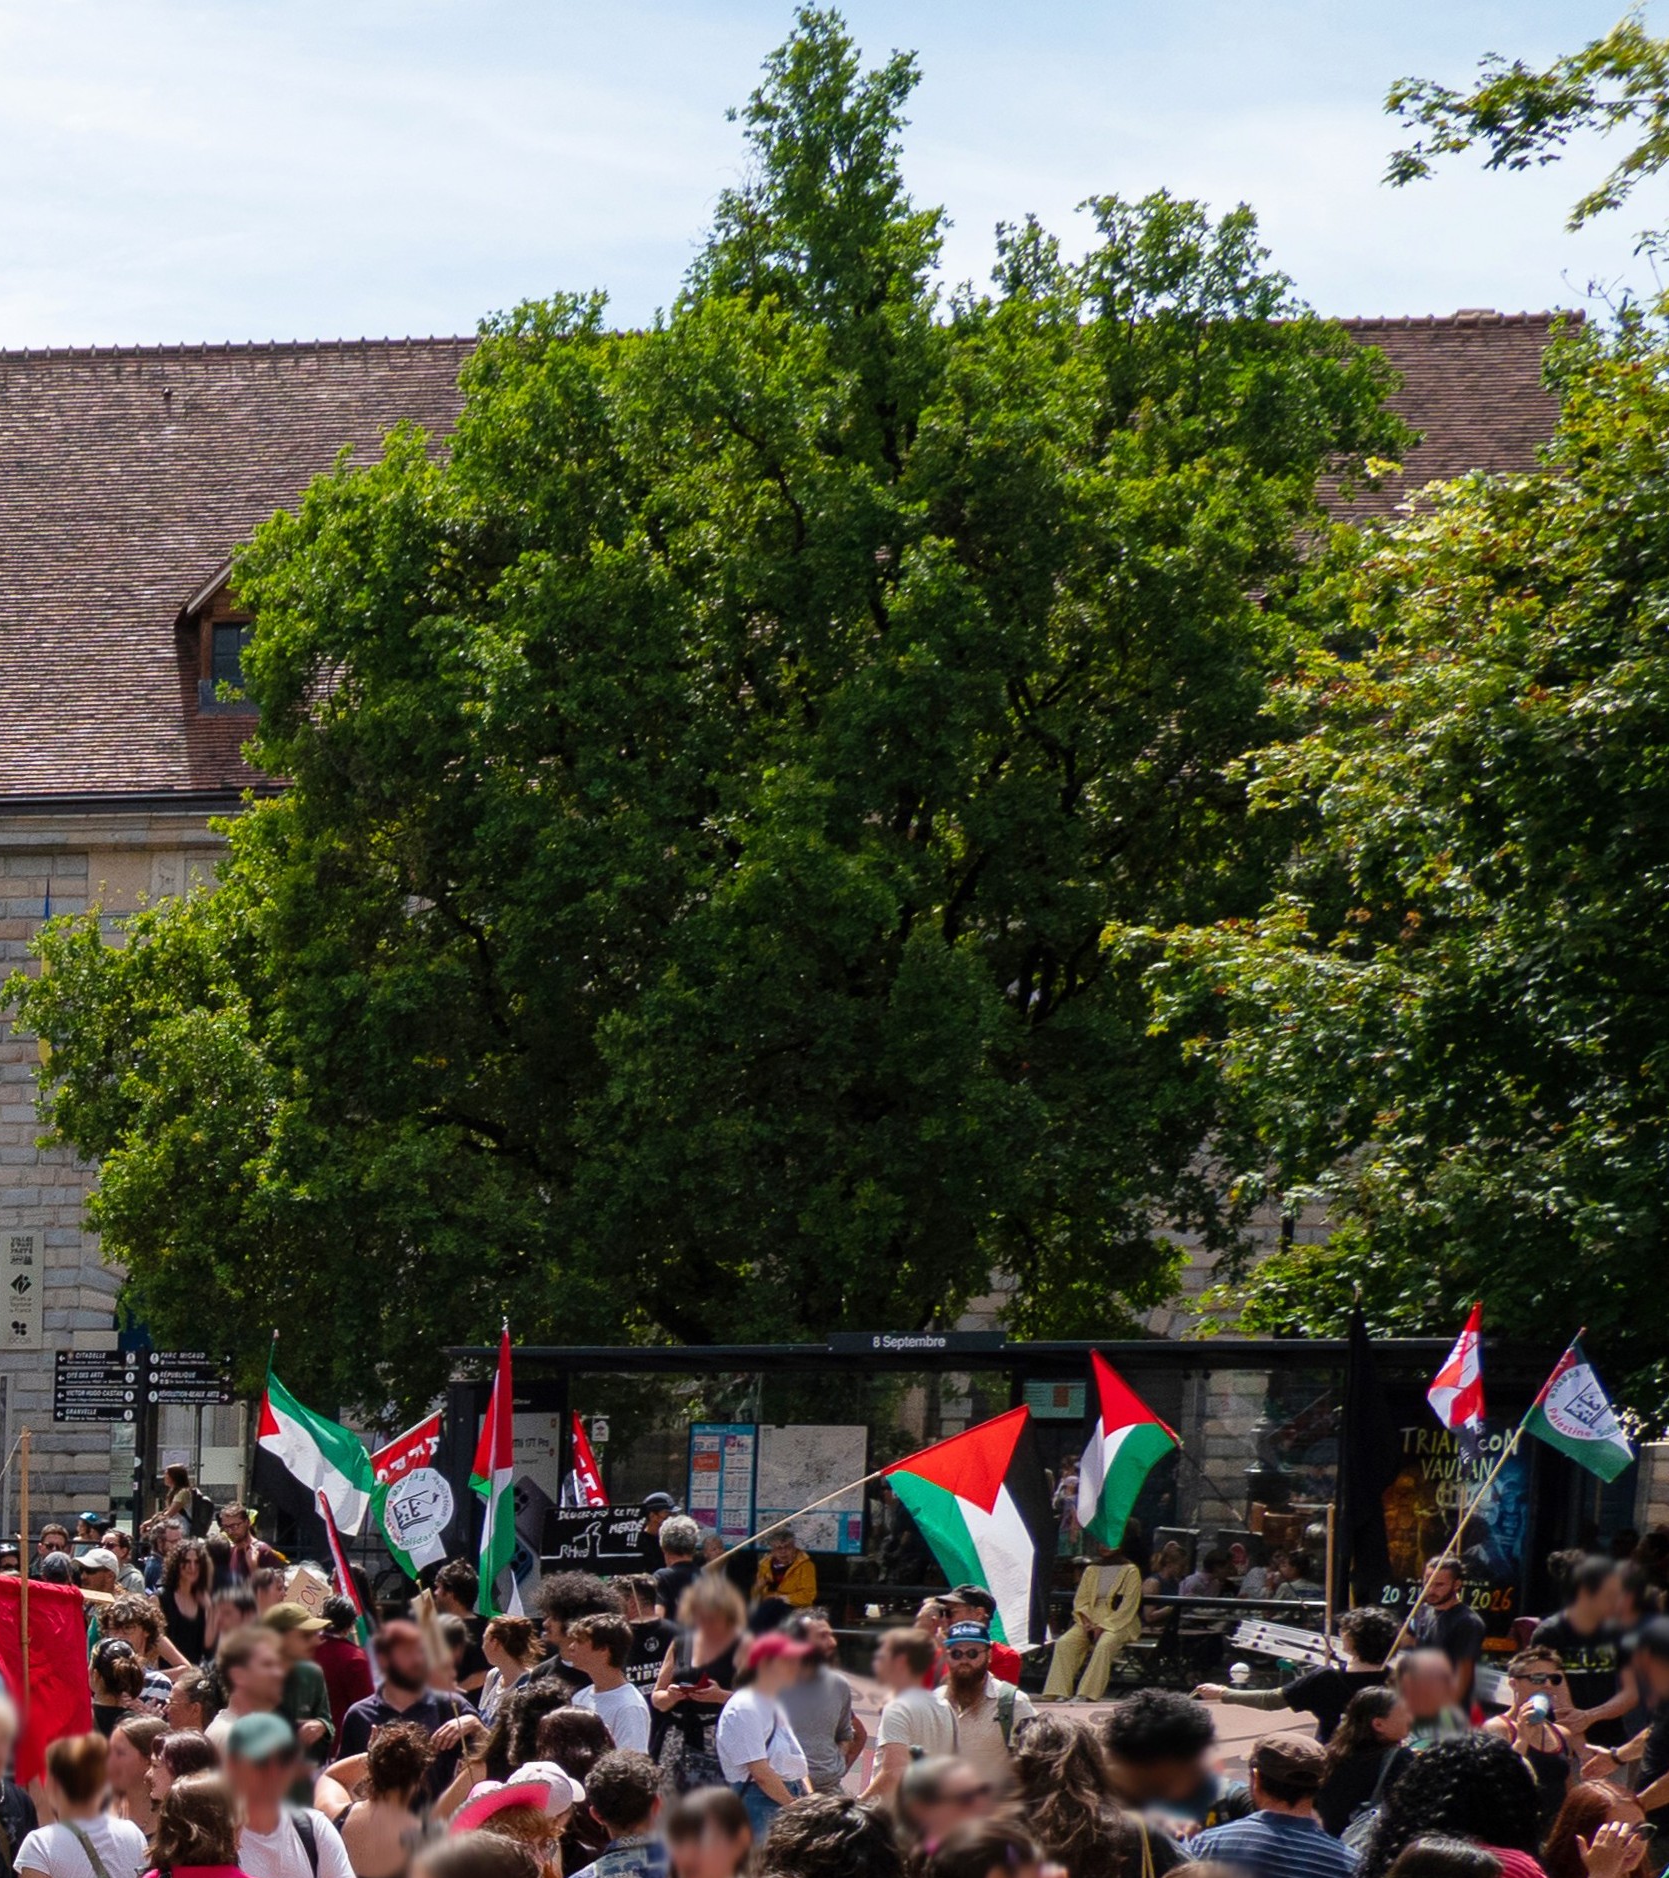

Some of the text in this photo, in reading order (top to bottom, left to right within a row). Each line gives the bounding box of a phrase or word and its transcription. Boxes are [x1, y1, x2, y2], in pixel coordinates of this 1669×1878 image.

[872, 1335, 947, 1350] 8 Septembre
[74, 1351, 107, 1359] CITADELLE
[90, 1371, 104, 1379] ARTS
[159, 1370, 197, 1379] RÉPUBLIQUE
[1548, 1368, 1580, 1400] France
[65, 1389, 86, 1397] VICTOR
[1548, 1407, 1592, 1438] Palestine
[1380, 1584, 1401, 1604] 20
[1469, 1586, 1515, 1611] 2026
[625, 1661, 662, 1673] PALESTI
[625, 1668, 662, 1682] LIBR
